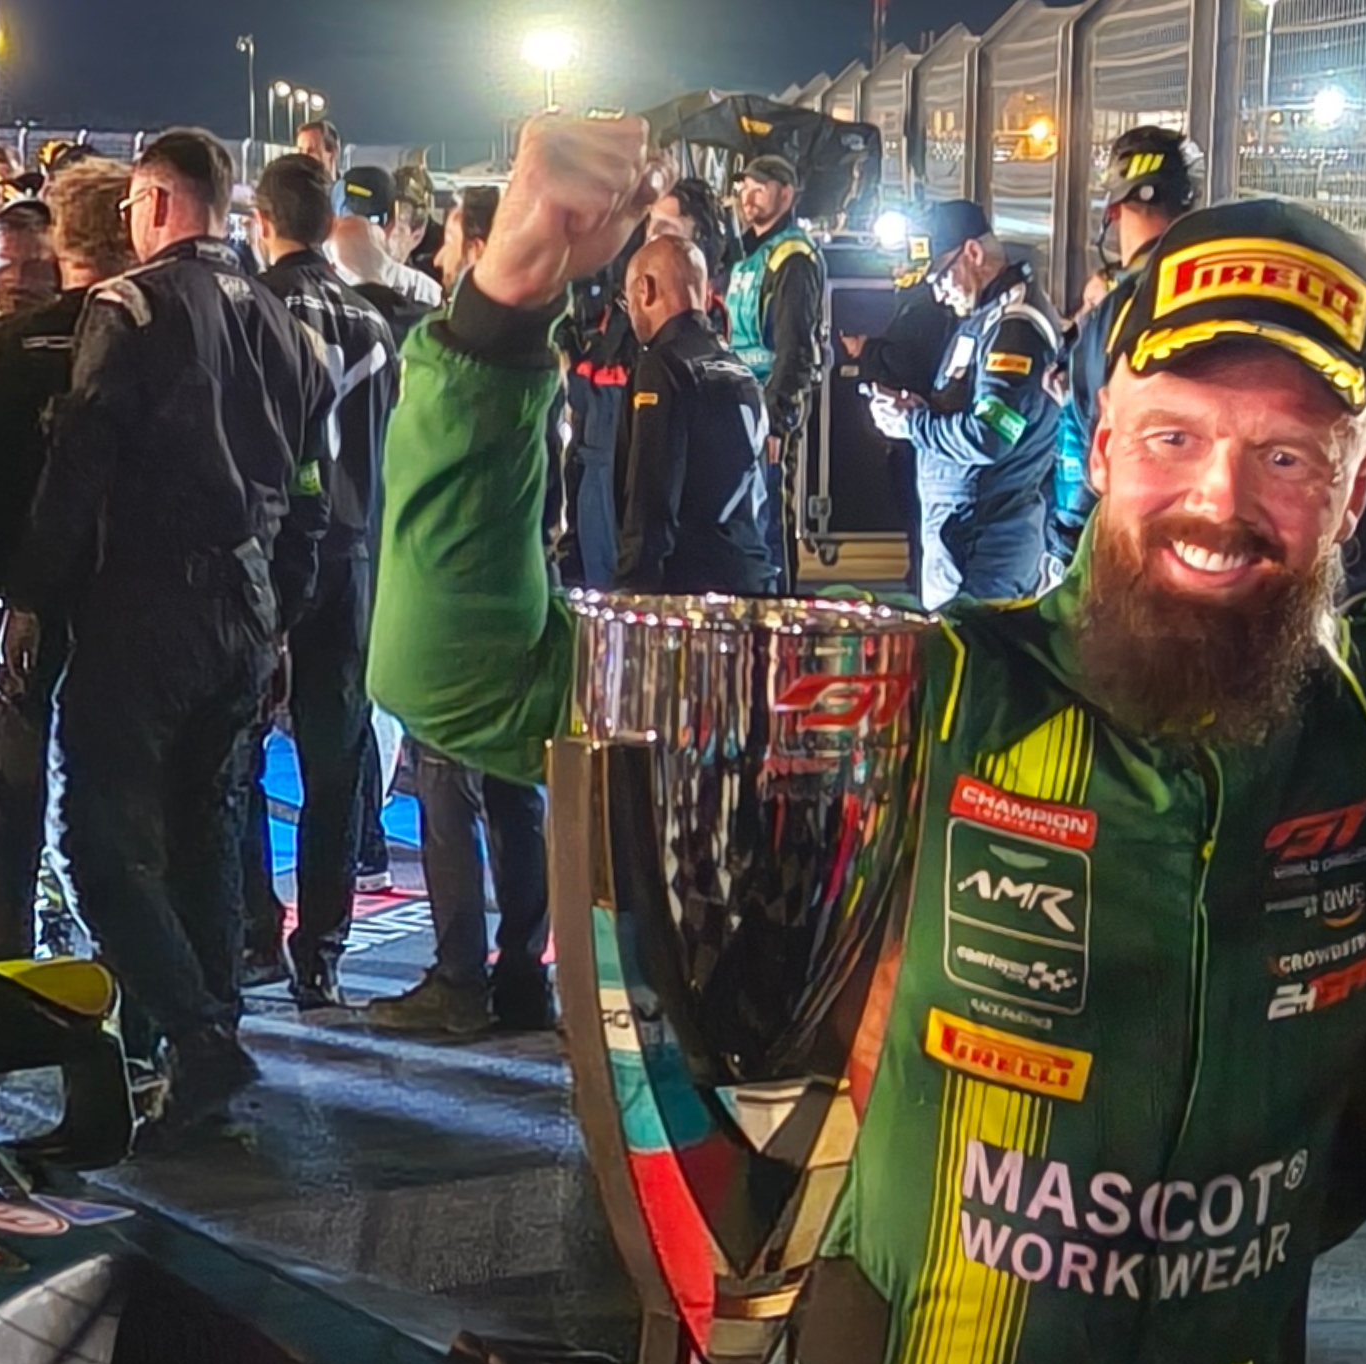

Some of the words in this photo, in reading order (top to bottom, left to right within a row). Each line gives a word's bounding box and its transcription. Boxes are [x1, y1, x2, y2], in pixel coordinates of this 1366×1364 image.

[1173, 251, 1359, 326] PIRELLI
[961, 785, 1089, 834] CHAMPION
[956, 869, 1076, 933] AMR
[940, 1023, 1075, 1087] PIRELLI
